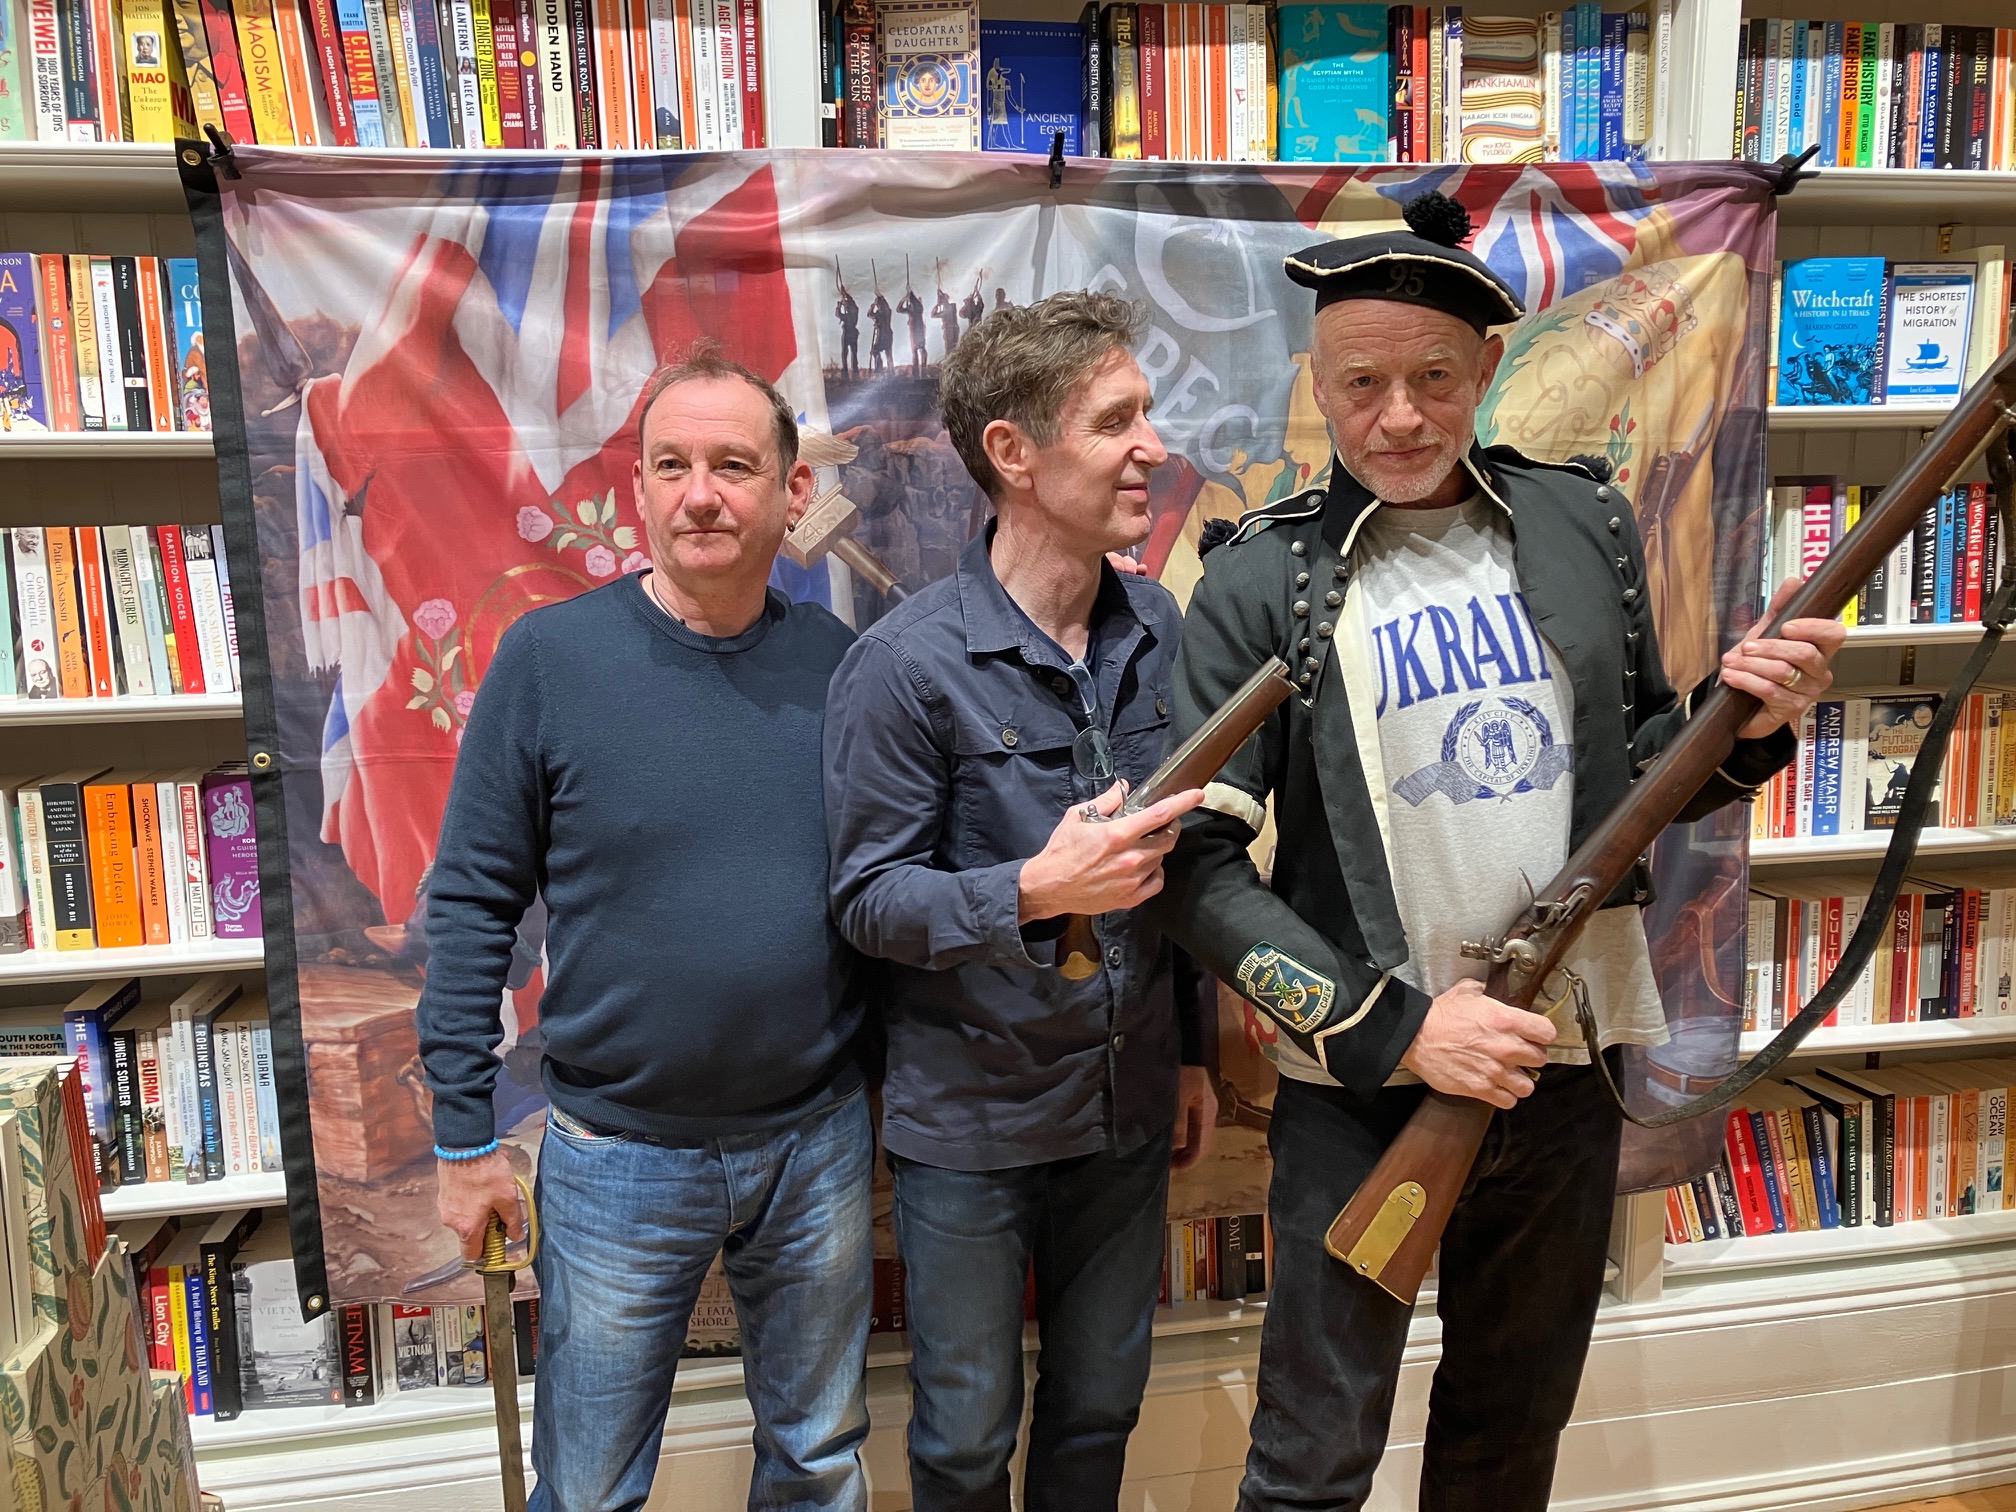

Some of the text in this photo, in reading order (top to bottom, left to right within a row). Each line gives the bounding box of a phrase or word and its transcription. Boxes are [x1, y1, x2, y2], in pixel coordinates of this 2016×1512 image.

[405, 37, 417, 65] Darren
[475, 18, 495, 82] DANGER ZONE
[496, 34, 515, 42] LITTLE
[888, 25, 964, 36] CLEOPATRA'S
[894, 37, 960, 48] DAUGHTER
[1660, 22, 1670, 74] ETRUSCANS
[245, 15, 272, 92] MAOISM
[351, 35, 376, 95] CHINA
[455, 7, 475, 117] LANTERNS ALEC ASH
[498, 60, 518, 68] SISTER
[549, 51, 565, 92] HAND
[575, 16, 589, 92] DIGITAL SILK ROAD
[721, 37, 735, 79] AMBITION
[849, 32, 861, 102] OF THE SUN
[861, 34, 871, 102] PHARAOHS
[1562, 23, 1574, 99] CLEOPATRA
[1603, 33, 1614, 72] Trumpet
[1614, 17, 1625, 87] Tutankhamun's
[1796, 43, 1805, 71] shock
[1843, 27, 1860, 101] FAKE HEROES
[1860, 31, 1877, 107] FAKE HISTORY
[1929, 51, 1938, 91] MAIDEN
[1974, 32, 1987, 85] CRUCIBLE
[38, 73, 51, 114] SORROWS
[131, 72, 166, 84] MAO
[141, 87, 157, 95] The
[325, 46, 347, 127] HUGH TREVOR-ROPER
[746, 55, 758, 93] UYGHURS
[1091, 54, 1099, 111] ROSETTA STONE
[1777, 25, 1792, 135] VITAL ORGANS
[51, 77, 64, 132] YEARS JOYS
[133, 95, 168, 103] Unknown
[140, 104, 162, 113] Story
[526, 74, 538, 131] Barbara Demick
[1026, 113, 1075, 124] ANCIENT
[1431, 86, 1441, 115] FACE
[1926, 95, 1936, 139] VOYAGES
[503, 120, 524, 128] CHANG
[1734, 128, 1742, 154] WARS
[48, 259, 60, 313] AMARTYA SEN
[1386, 263, 1426, 297] 95
[1792, 289, 1874, 308] Witchcraft
[1898, 292, 1967, 302] THE SHORTEST
[76, 301, 91, 343] INDIA
[1903, 318, 1957, 327] MIGRATION
[1905, 305, 1960, 315] HISTORY of
[102, 304, 113, 358] SHORTEST HISTORY
[1876, 330, 1886, 371] STORY
[1956, 518, 1967, 552] FAMOUS
[1969, 504, 1984, 544] WOMEN
[52, 542, 69, 622] Patient Assassin
[116, 548, 133, 597] MIDNIGHT'S
[165, 533, 187, 621] PARTITION VOICES
[1923, 540, 1935, 589] WATCH
[25, 572, 38, 628] CHURCHILL
[124, 597, 138, 625] FURIES
[1474, 711, 1514, 724] KIEV CITY
[1825, 706, 1842, 815] ANDREW MARR
[1882, 735, 1919, 745] FUTURE
[1464, 756, 1473, 767] THE
[1474, 770, 1503, 783] CAPITAL
[1516, 746, 1534, 776] UKRAINE
[182, 790, 198, 851] PURE INVENTION
[105, 793, 124, 905] Embracing Defeat
[141, 798, 158, 907] SHOCKWAVE STEPHEN WALKER
[191, 884, 203, 921] MATT ALT
[1965, 896, 1976, 949] BLOOD LEGACY
[102, 920, 134, 928] DOWER
[1239, 955, 1260, 980] SHARPE
[1300, 984, 1333, 1031] VALIANT CREW
[29, 1034, 63, 1042] KOREA
[74, 1015, 91, 1074] THE NEW
[114, 1037, 131, 1107] JUNGLE SOLDIER
[195, 1031, 210, 1088] ROHINGYAS
[257, 1054, 270, 1087] BURMA
[140, 1059, 160, 1105] BURMA
[226, 1091, 237, 1121] FREEDOM
[1989, 1096, 1999, 1137] OCEAN
[1755, 1117, 1774, 1178] PILGRIMAGE
[1781, 1113, 1792, 1144] RISE
[207, 1268, 221, 1331] King Never Smiles
[155, 1295, 170, 1346] Lion City
[690, 1317, 730, 1327] SHORE
[195, 1345, 209, 1386] THAILAND
[398, 1344, 433, 1358] VIETNAM
